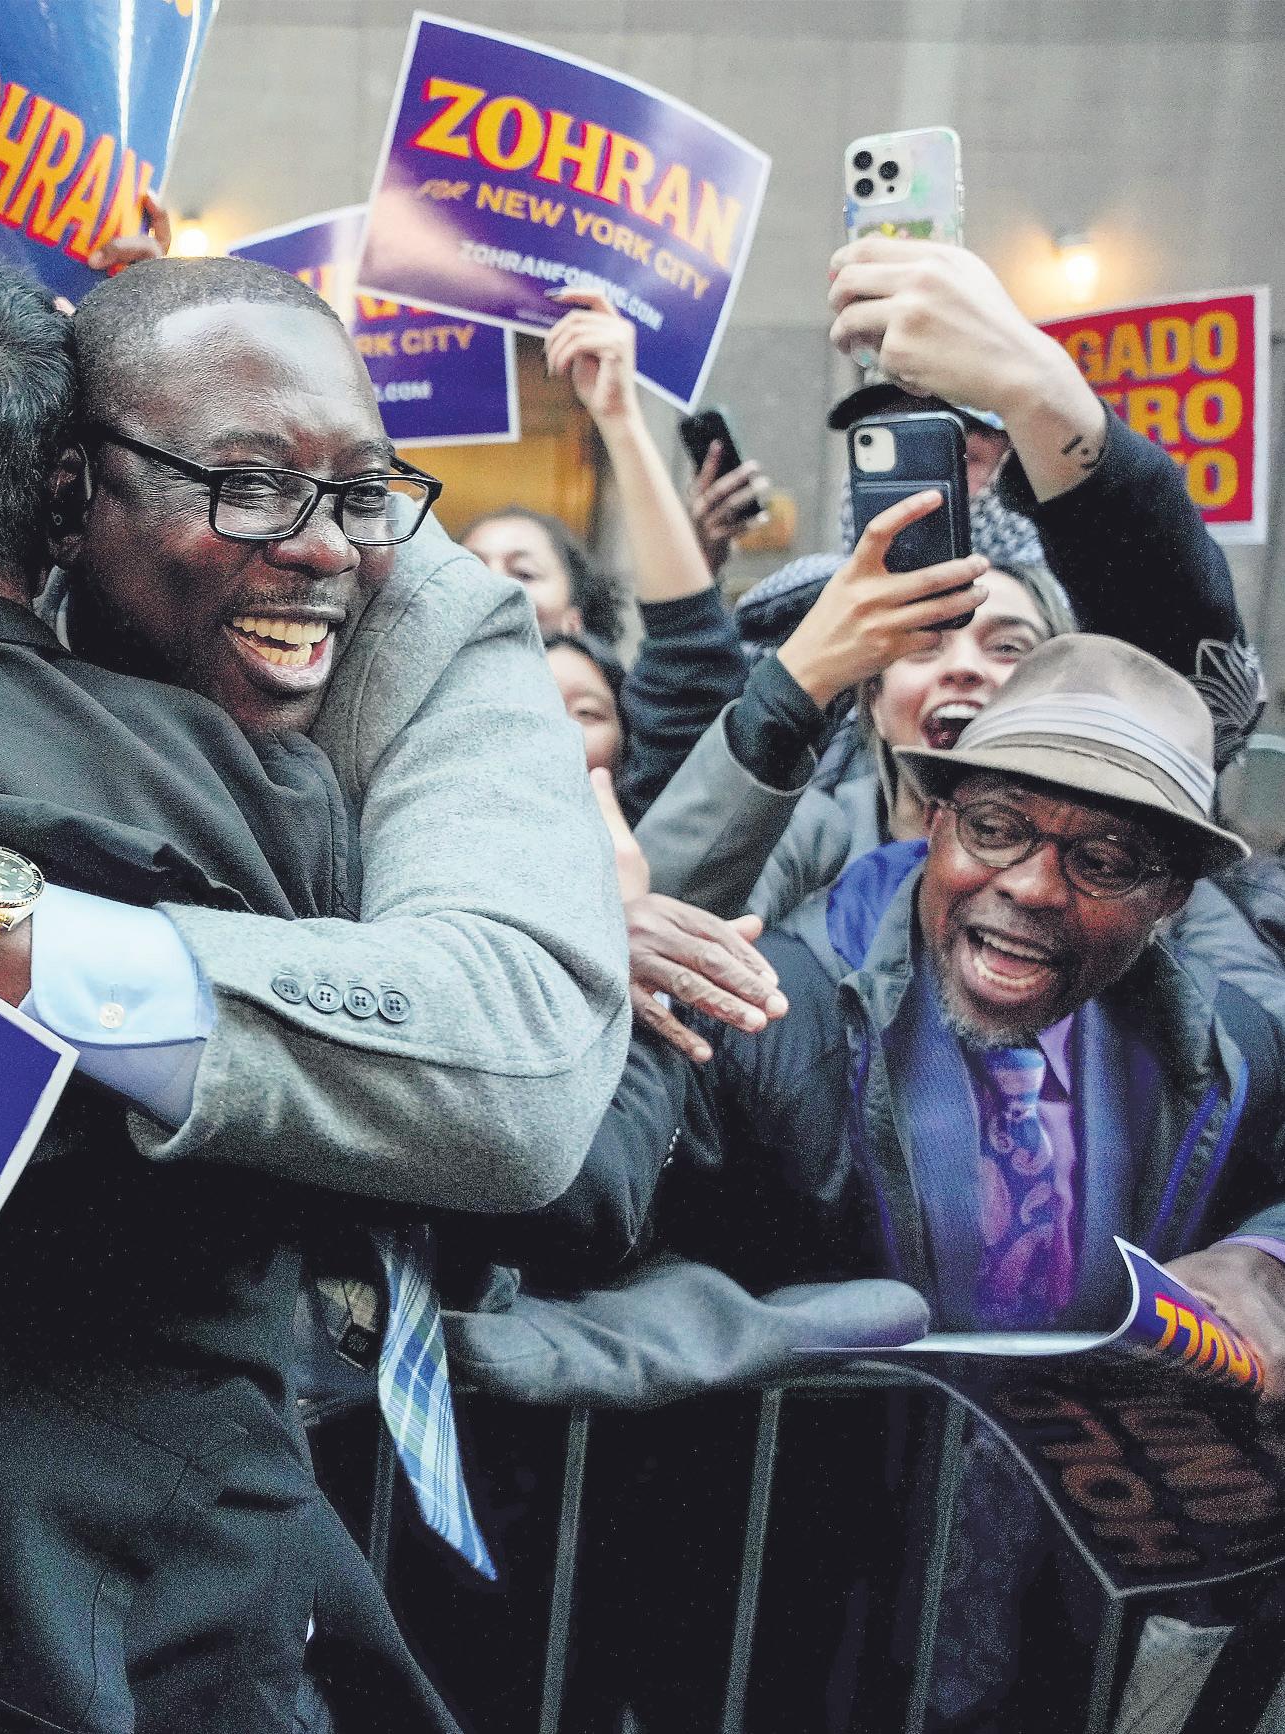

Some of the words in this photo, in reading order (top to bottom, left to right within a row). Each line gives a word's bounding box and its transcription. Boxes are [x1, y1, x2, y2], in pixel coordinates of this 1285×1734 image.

[408, 77, 742, 271] ZOHRAN
[475, 183, 565, 229] NEW
[572, 206, 655, 265] YORK
[653, 249, 711, 299] CITY
[401, 323, 475, 355] CITY
[1062, 310, 1239, 390] GADO
